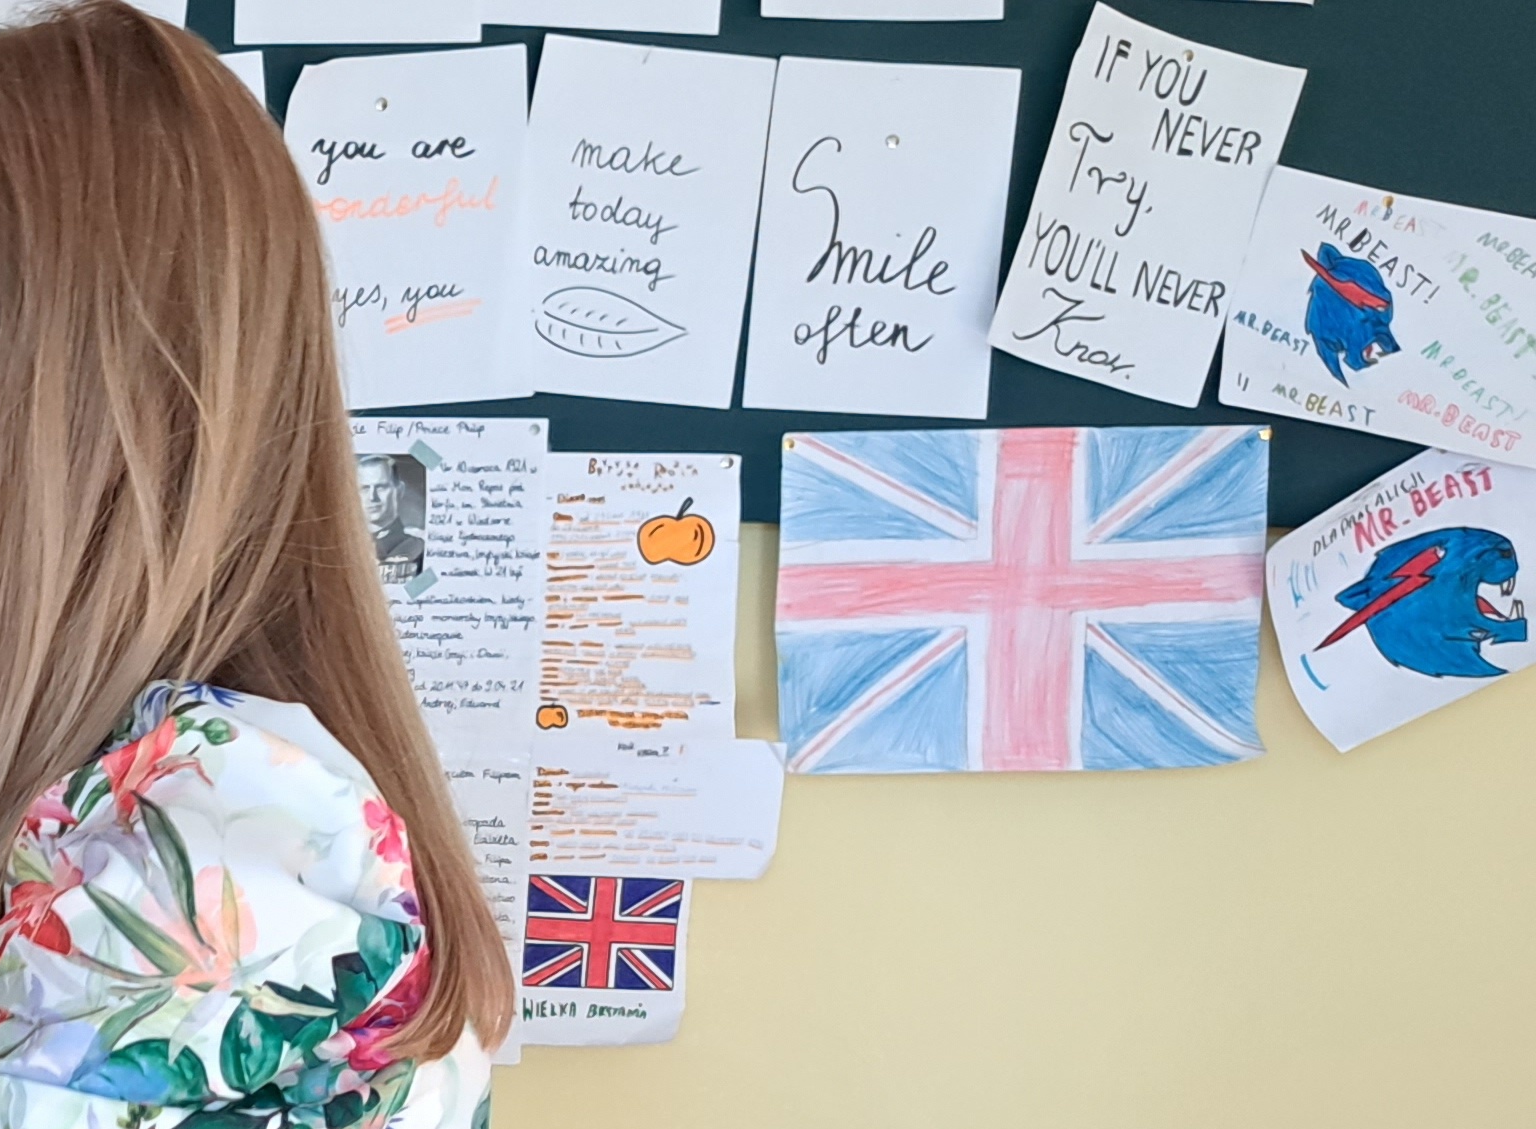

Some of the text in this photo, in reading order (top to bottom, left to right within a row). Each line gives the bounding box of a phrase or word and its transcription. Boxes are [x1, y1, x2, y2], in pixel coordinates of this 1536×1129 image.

[1094, 34, 1208, 106] IF YOU
[310, 135, 478, 186] you are
[571, 136, 701, 177] make
[1152, 108, 1262, 166] NEVER
[314, 175, 499, 228] onderful
[569, 182, 679, 244] today
[792, 136, 958, 295] Smile
[533, 244, 677, 290] amazing
[1027, 212, 1226, 318] YOU'LL NEVER
[332, 282, 466, 329] yes, you
[794, 304, 935, 365] often
